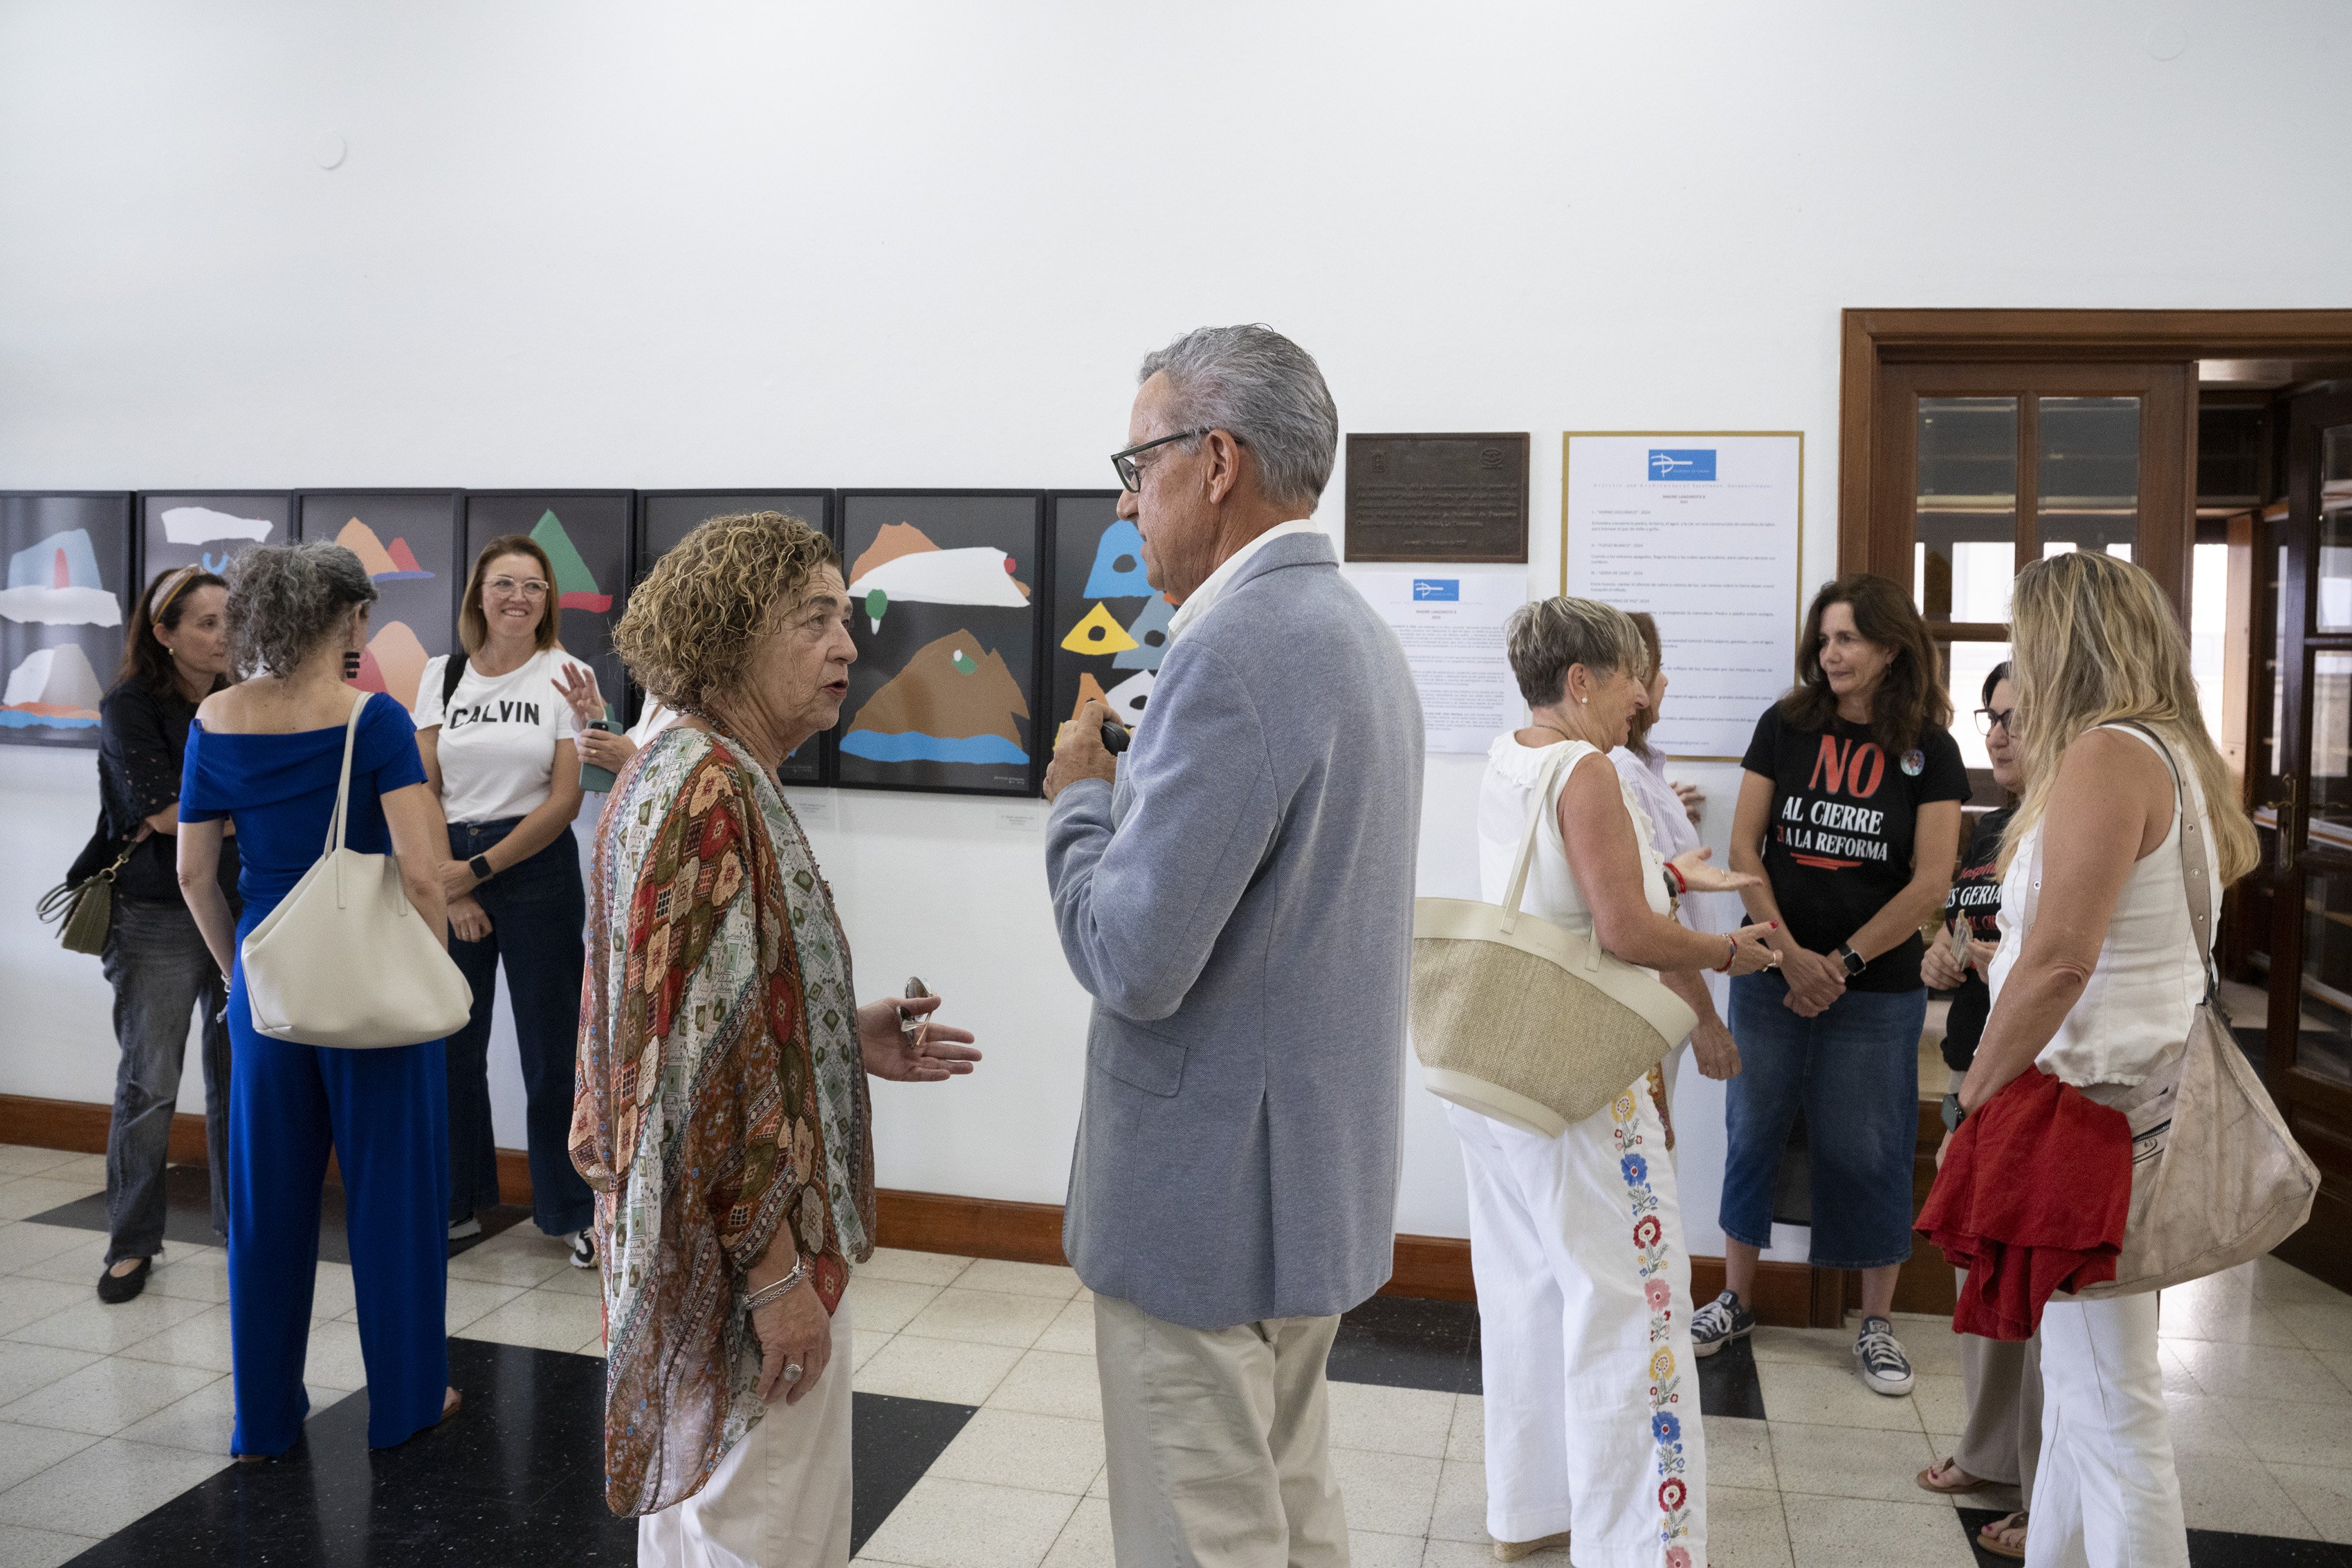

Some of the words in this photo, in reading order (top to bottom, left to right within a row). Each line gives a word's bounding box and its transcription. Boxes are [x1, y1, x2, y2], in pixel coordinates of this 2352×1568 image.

[450, 701, 540, 730] CALVIN
[1808, 735, 1885, 798] NO
[1782, 796, 1804, 822] AL
[1810, 800, 1884, 835] CIERRE
[1785, 827, 1792, 847] A
[1794, 829, 1812, 849] LA
[1814, 832, 1888, 861] REFORMA
